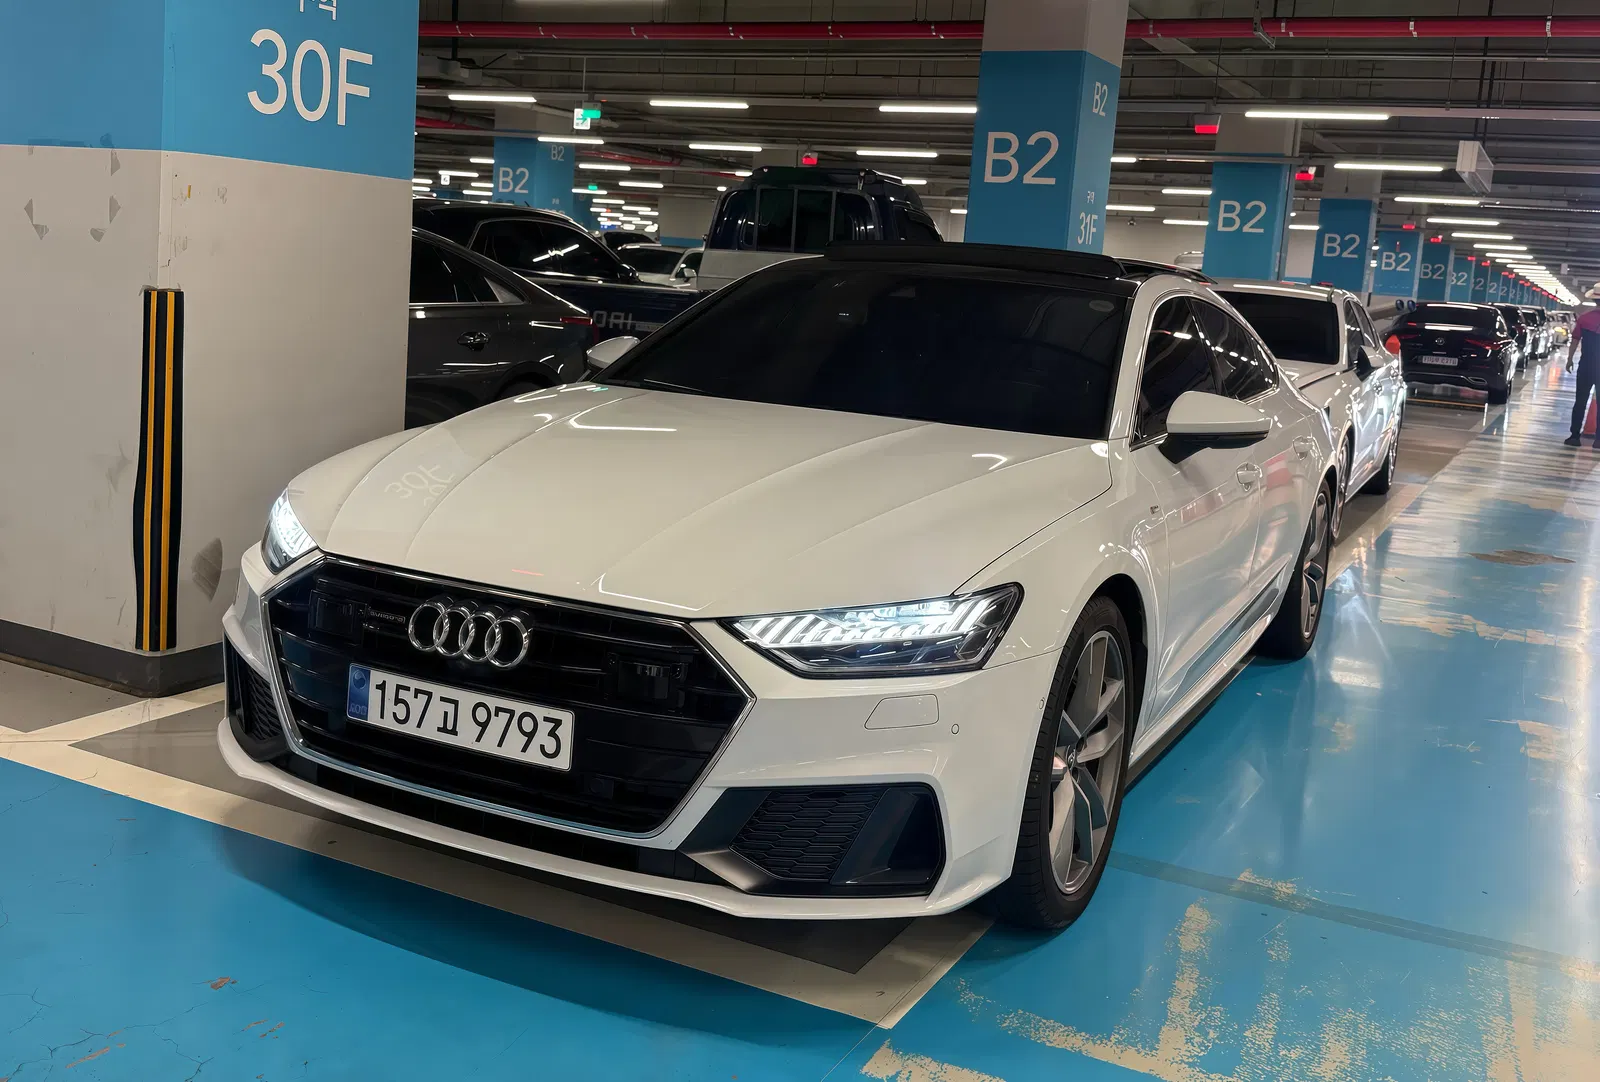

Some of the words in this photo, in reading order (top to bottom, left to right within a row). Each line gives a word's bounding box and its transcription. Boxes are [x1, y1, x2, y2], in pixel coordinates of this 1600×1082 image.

[247, 28, 373, 126] 30F
[1092, 81, 1108, 117] B2
[551, 145, 565, 162] B2
[983, 130, 1059, 185] B2
[498, 167, 530, 194] B2
[1077, 211, 1099, 245] 31F
[1217, 200, 1267, 233] B2
[1322, 233, 1360, 259] B2
[1381, 252, 1412, 272] B2
[1420, 264, 1445, 280] B2
[471, 701, 564, 759] 9793
